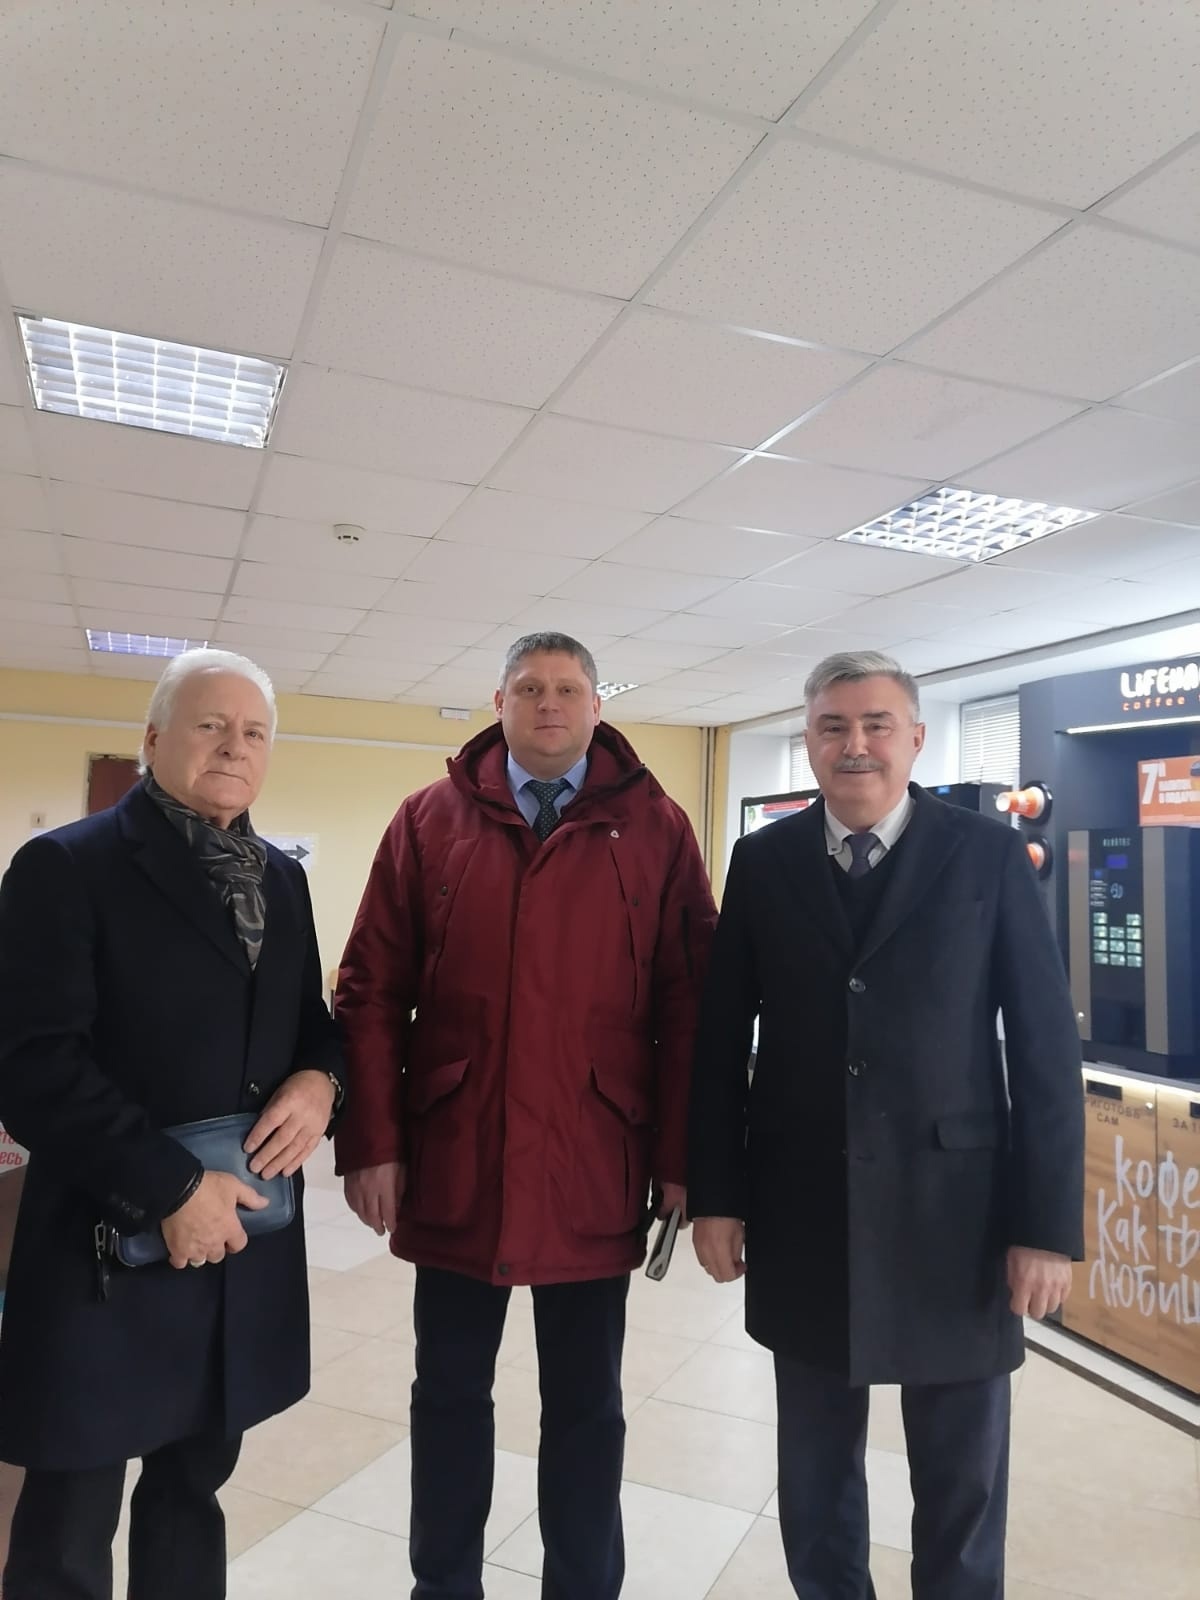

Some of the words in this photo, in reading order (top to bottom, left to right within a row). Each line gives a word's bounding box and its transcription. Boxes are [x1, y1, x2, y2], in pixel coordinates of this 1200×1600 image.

[1121, 663, 1200, 698] LIFEHA
[1123, 697, 1185, 711] coffee
[1097, 1113, 1119, 1126] САМ
